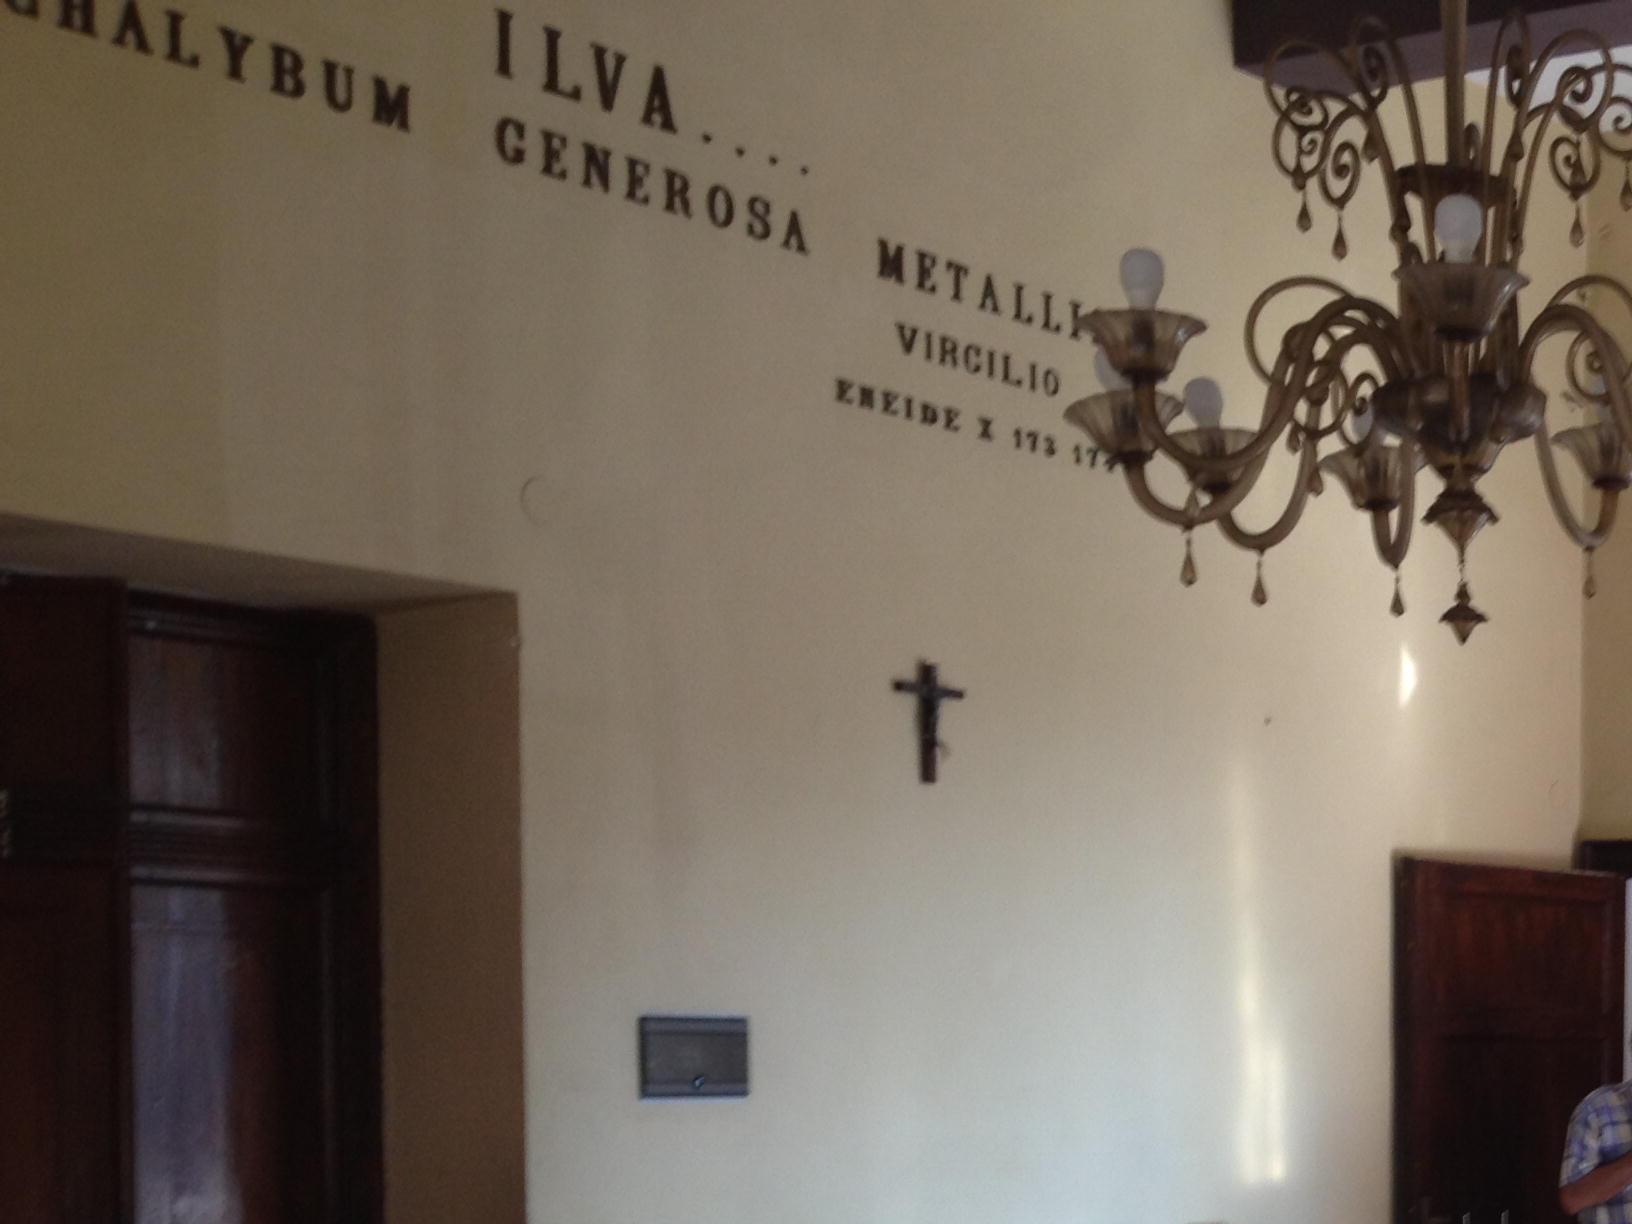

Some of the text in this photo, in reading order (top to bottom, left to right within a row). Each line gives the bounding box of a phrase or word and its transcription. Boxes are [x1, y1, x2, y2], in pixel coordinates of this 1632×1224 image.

[494, 116, 811, 256] GENEROSA
[877, 236, 1106, 346] METALLI
[833, 377, 962, 433] ENEIDE
[977, 415, 994, 442] X
[1012, 427, 1056, 458] 173
